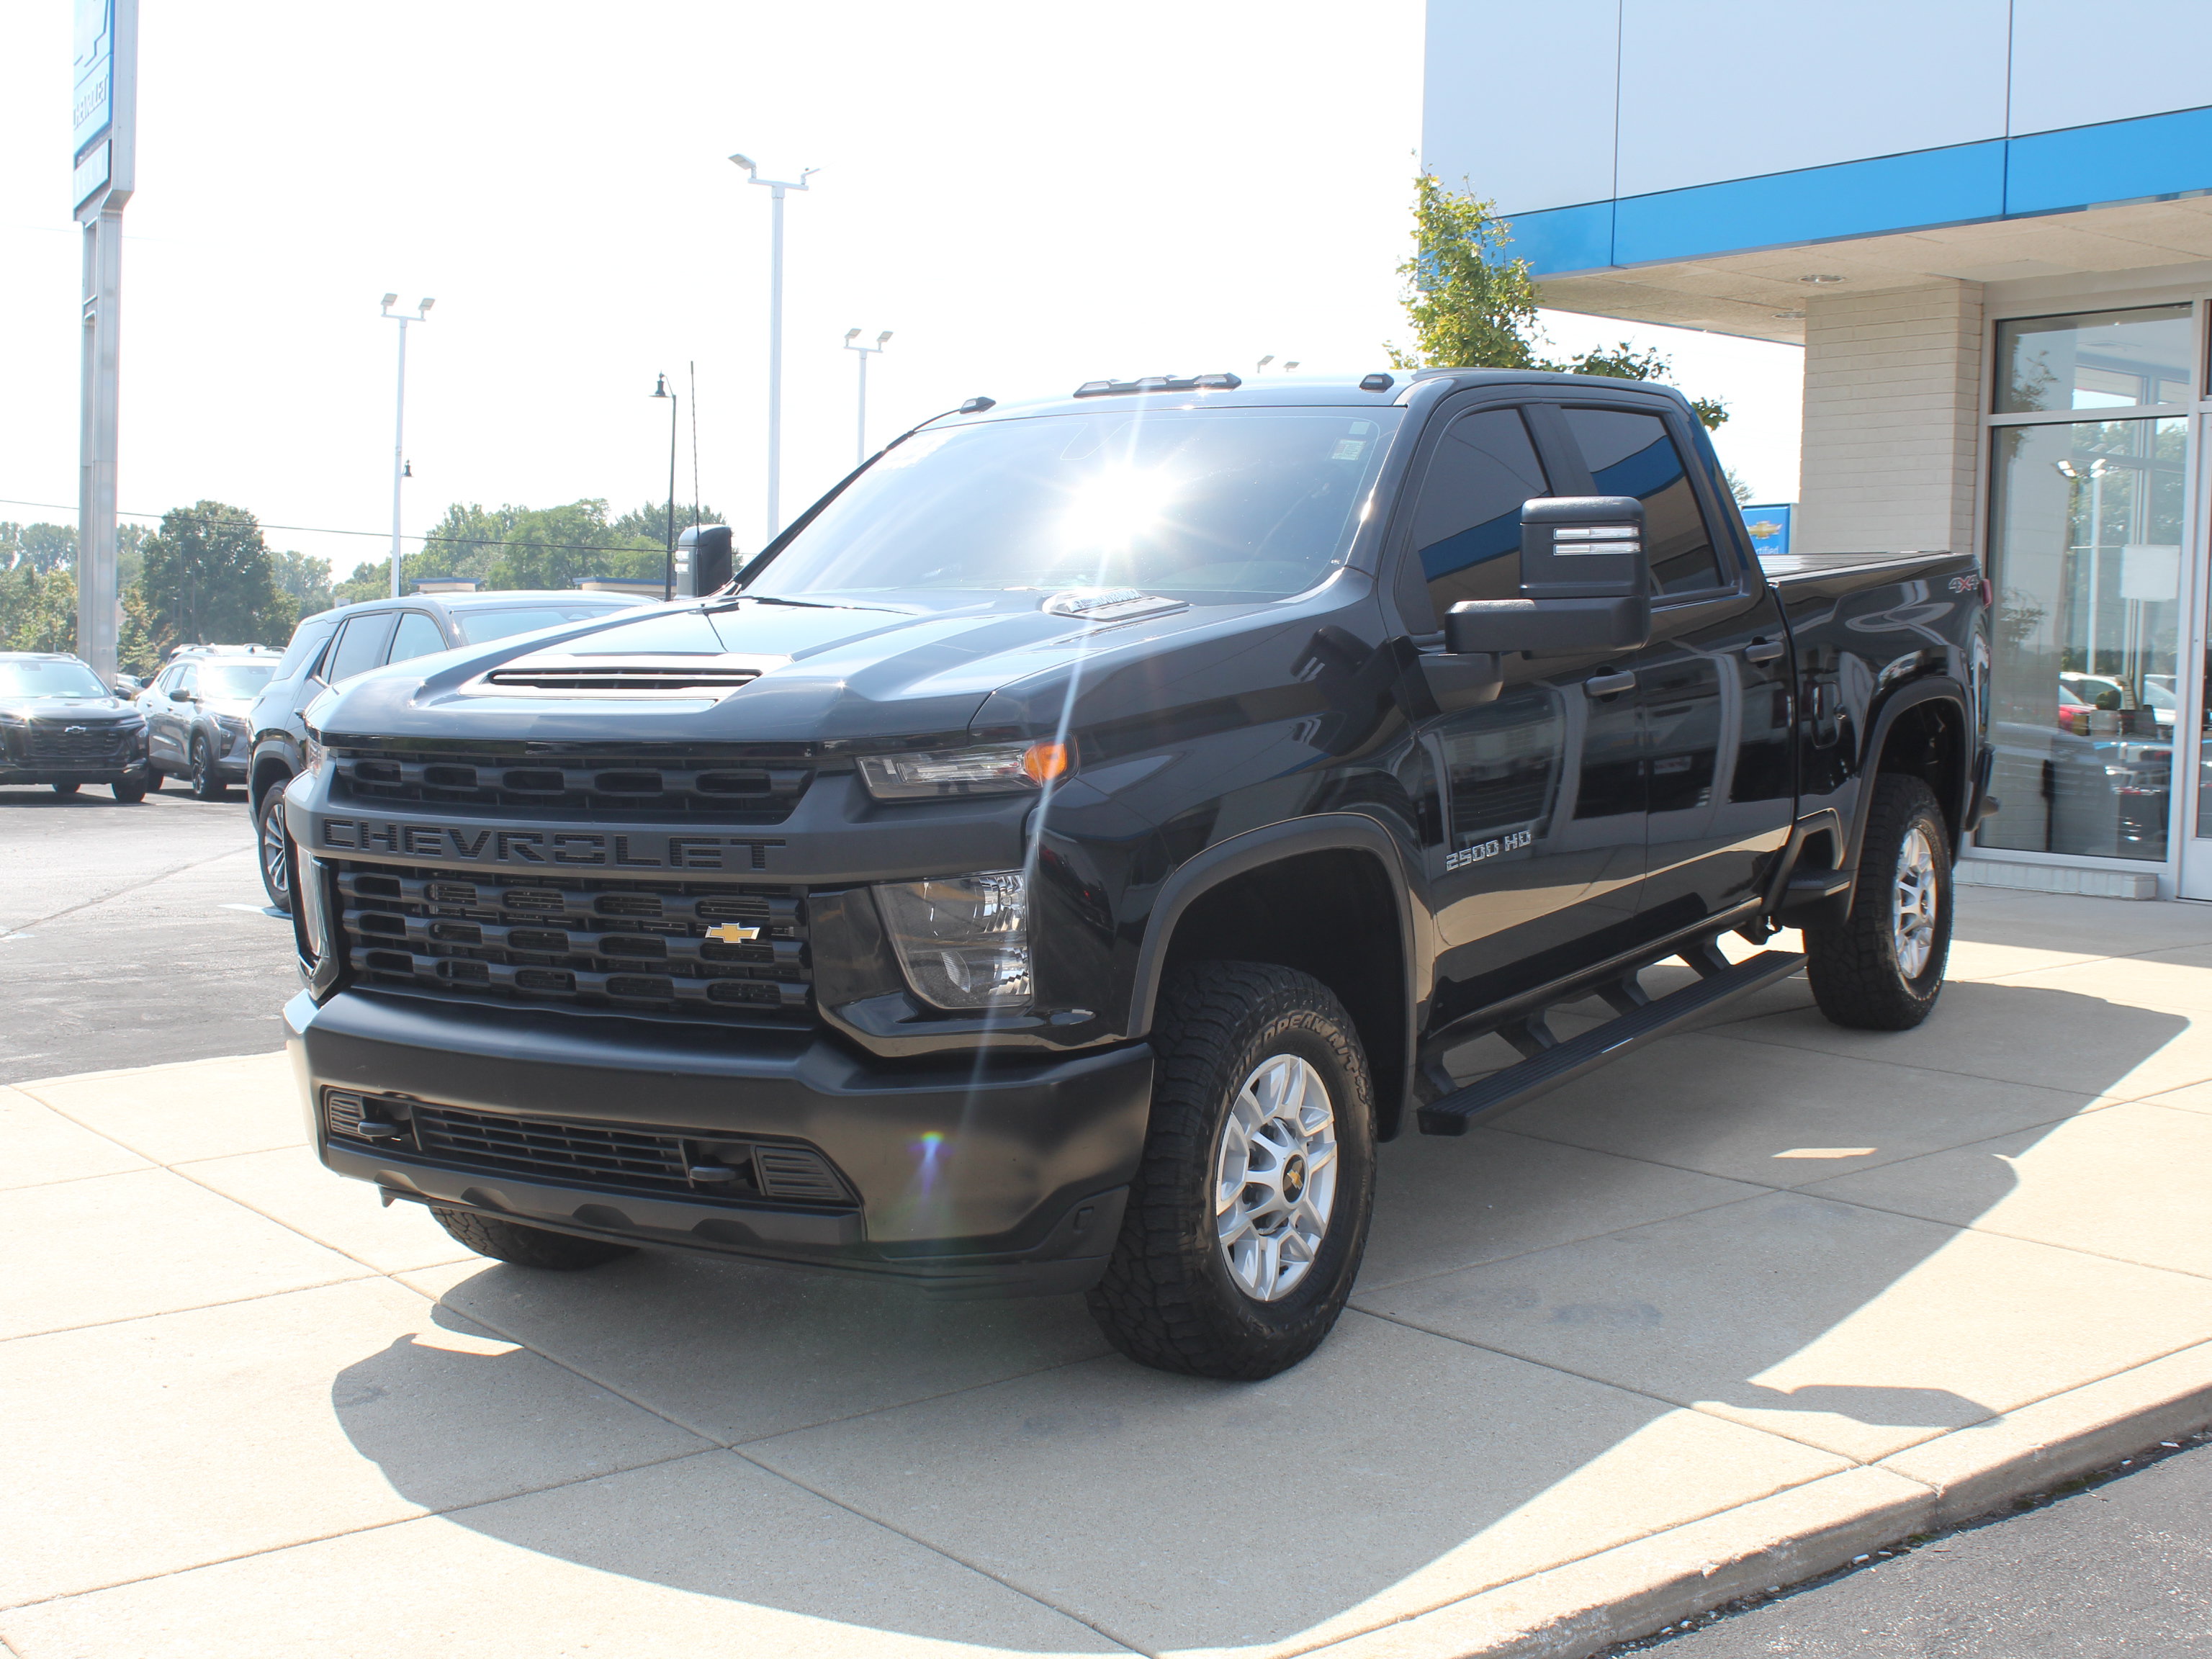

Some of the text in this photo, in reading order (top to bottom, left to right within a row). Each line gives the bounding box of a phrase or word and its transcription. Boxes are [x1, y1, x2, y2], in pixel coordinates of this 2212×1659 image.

[323, 818, 786, 870] CHEVROLET
[1446, 830, 1532, 871] 2500 HD
